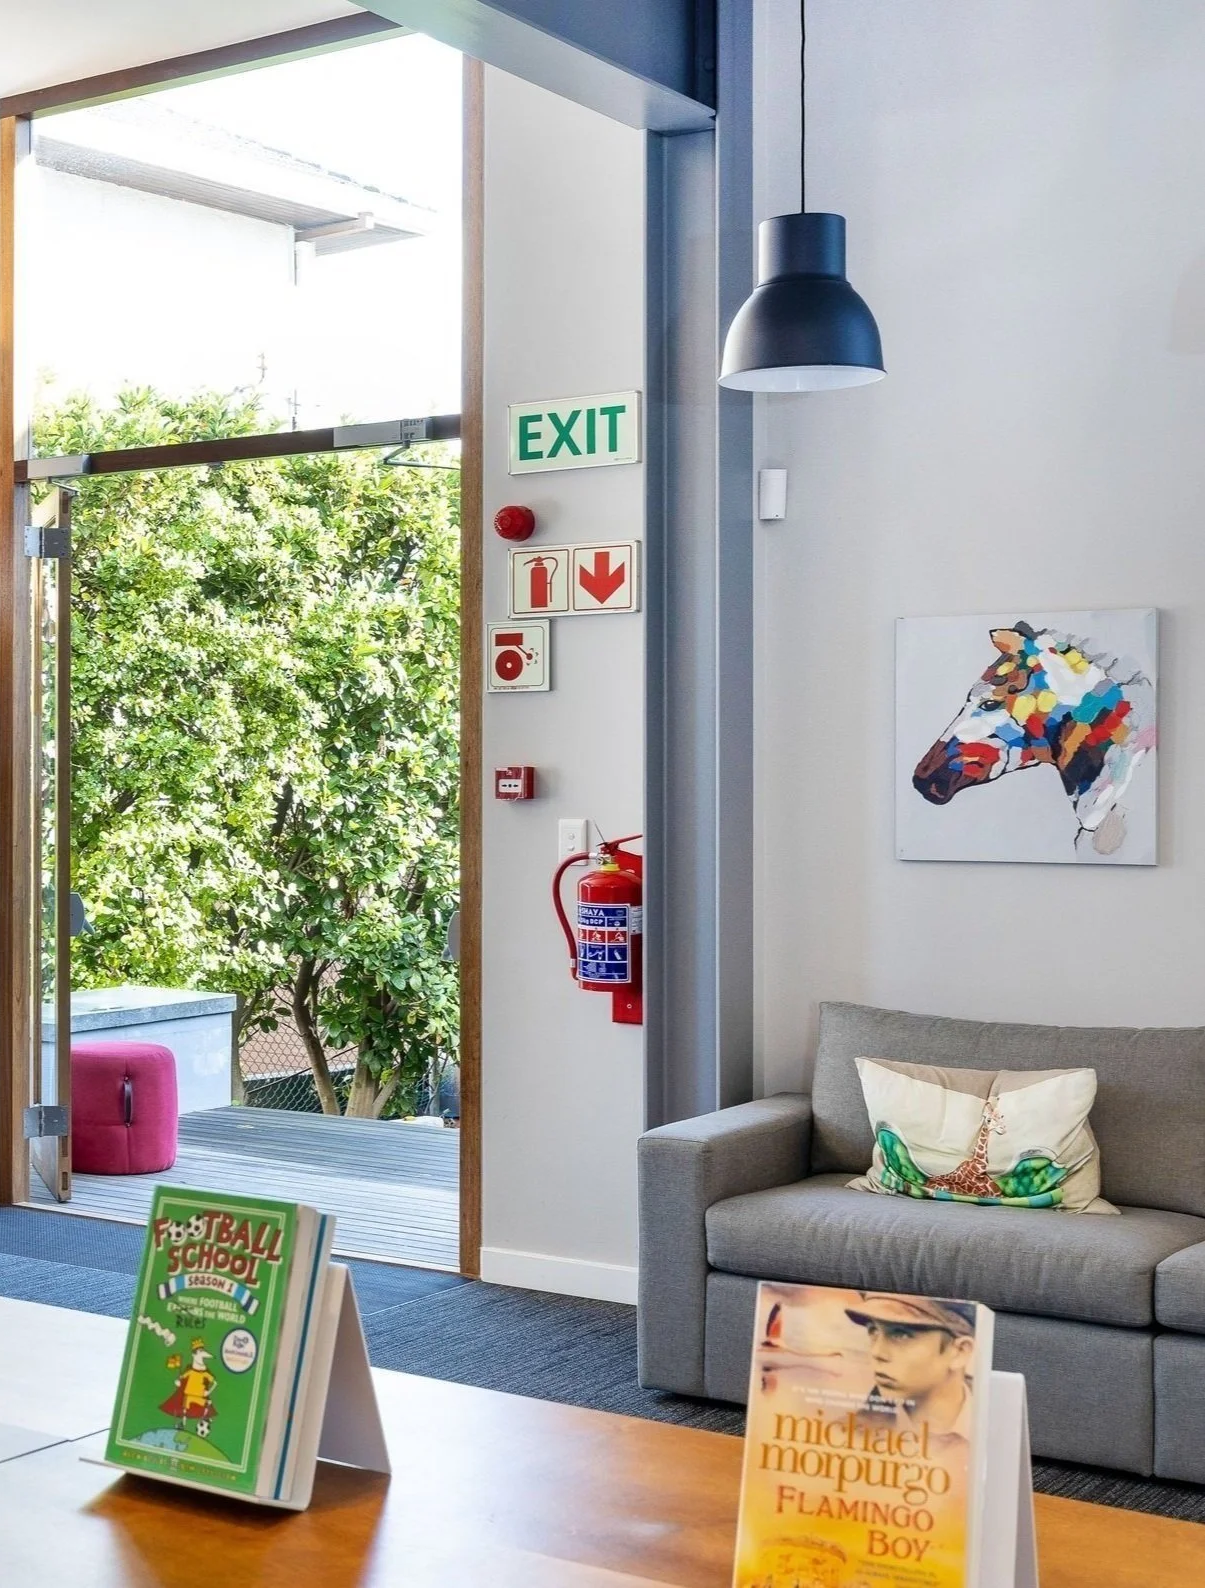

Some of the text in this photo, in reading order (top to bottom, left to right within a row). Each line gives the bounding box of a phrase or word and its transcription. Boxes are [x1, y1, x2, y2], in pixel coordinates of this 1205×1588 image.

[518, 405, 626, 461] EXIT
[153, 1211, 283, 1263] FOOTBALL
[168, 1244, 260, 1287] SCHOOL
[199, 1297, 238, 1312] FOOTBALL
[217, 1311, 246, 1324] WORLD
[773, 1410, 930, 1461] michael
[758, 1442, 951, 1507] morpurgo
[776, 1485, 935, 1533] FLAMINGO
[868, 1530, 931, 1562] BOY
